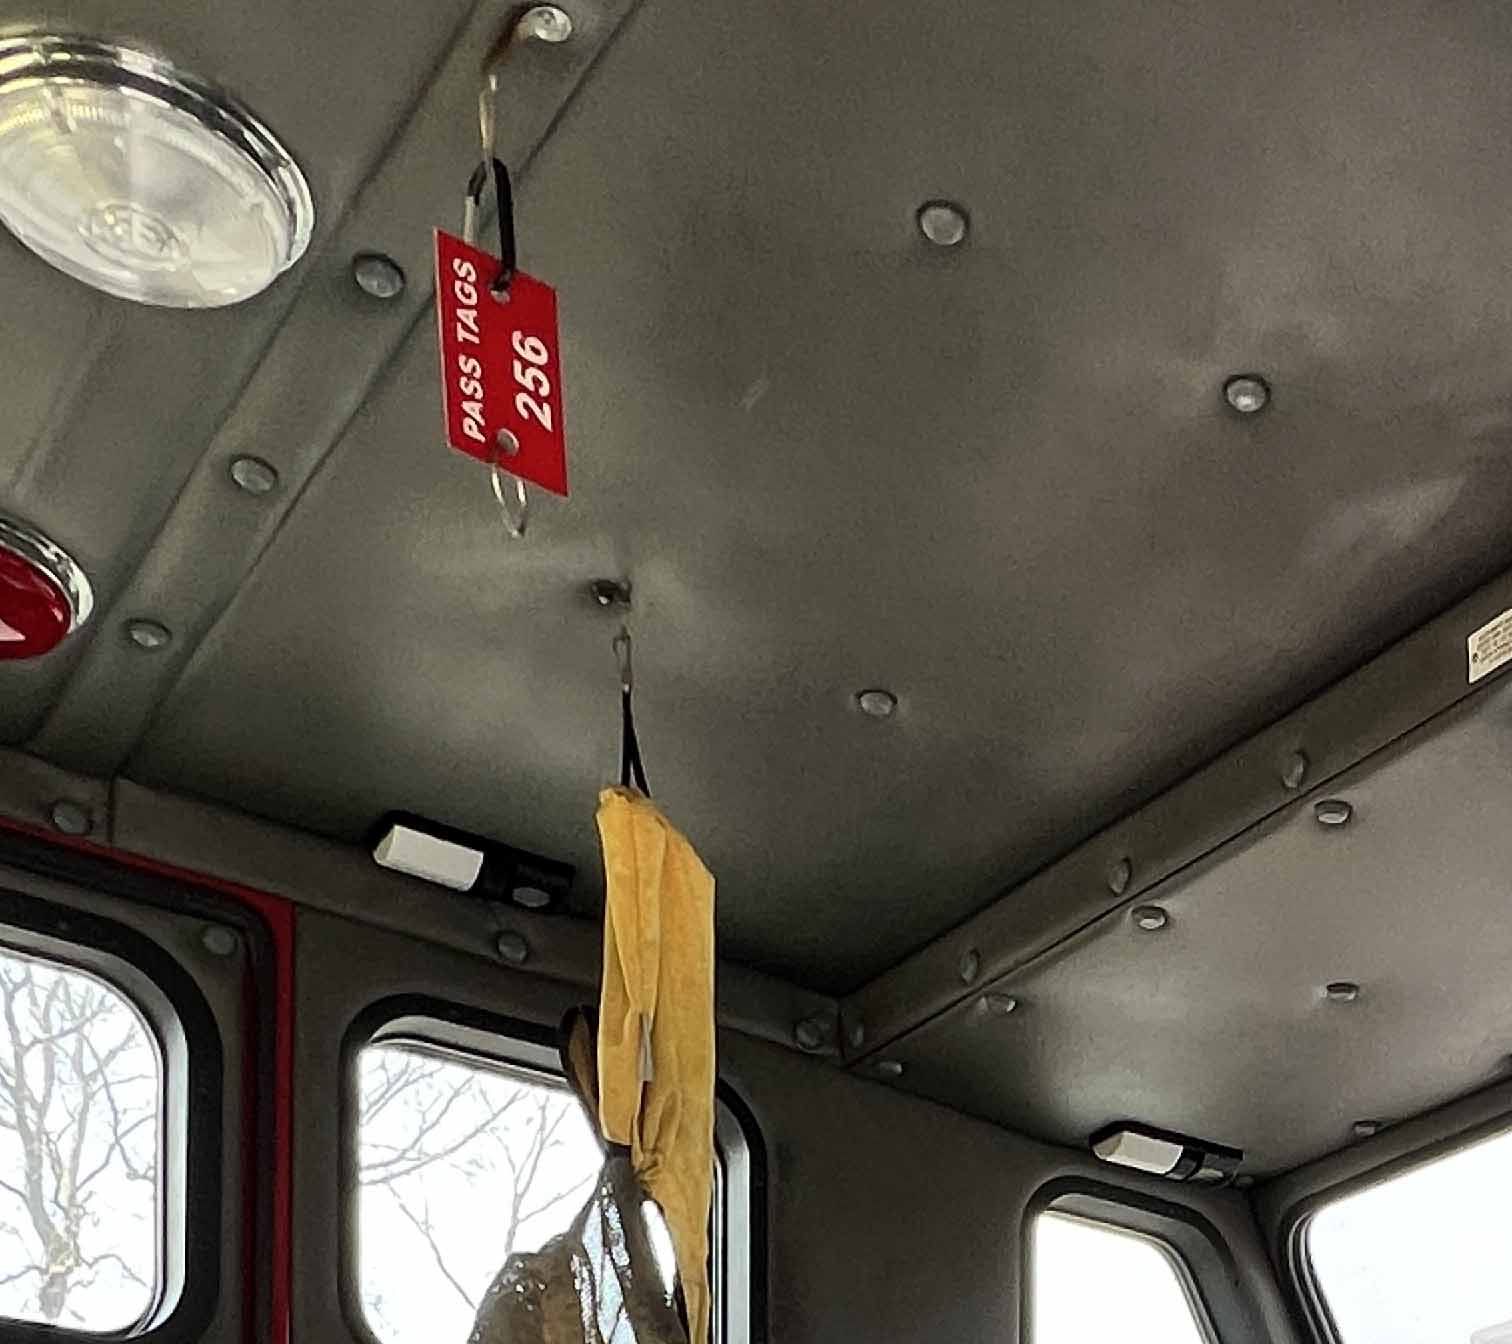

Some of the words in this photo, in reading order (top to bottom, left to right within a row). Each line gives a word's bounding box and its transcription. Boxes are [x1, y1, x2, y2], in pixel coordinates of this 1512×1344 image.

[453, 257, 481, 345] TAGS
[458, 354, 486, 443] PASS
[512, 330, 554, 433] 256
